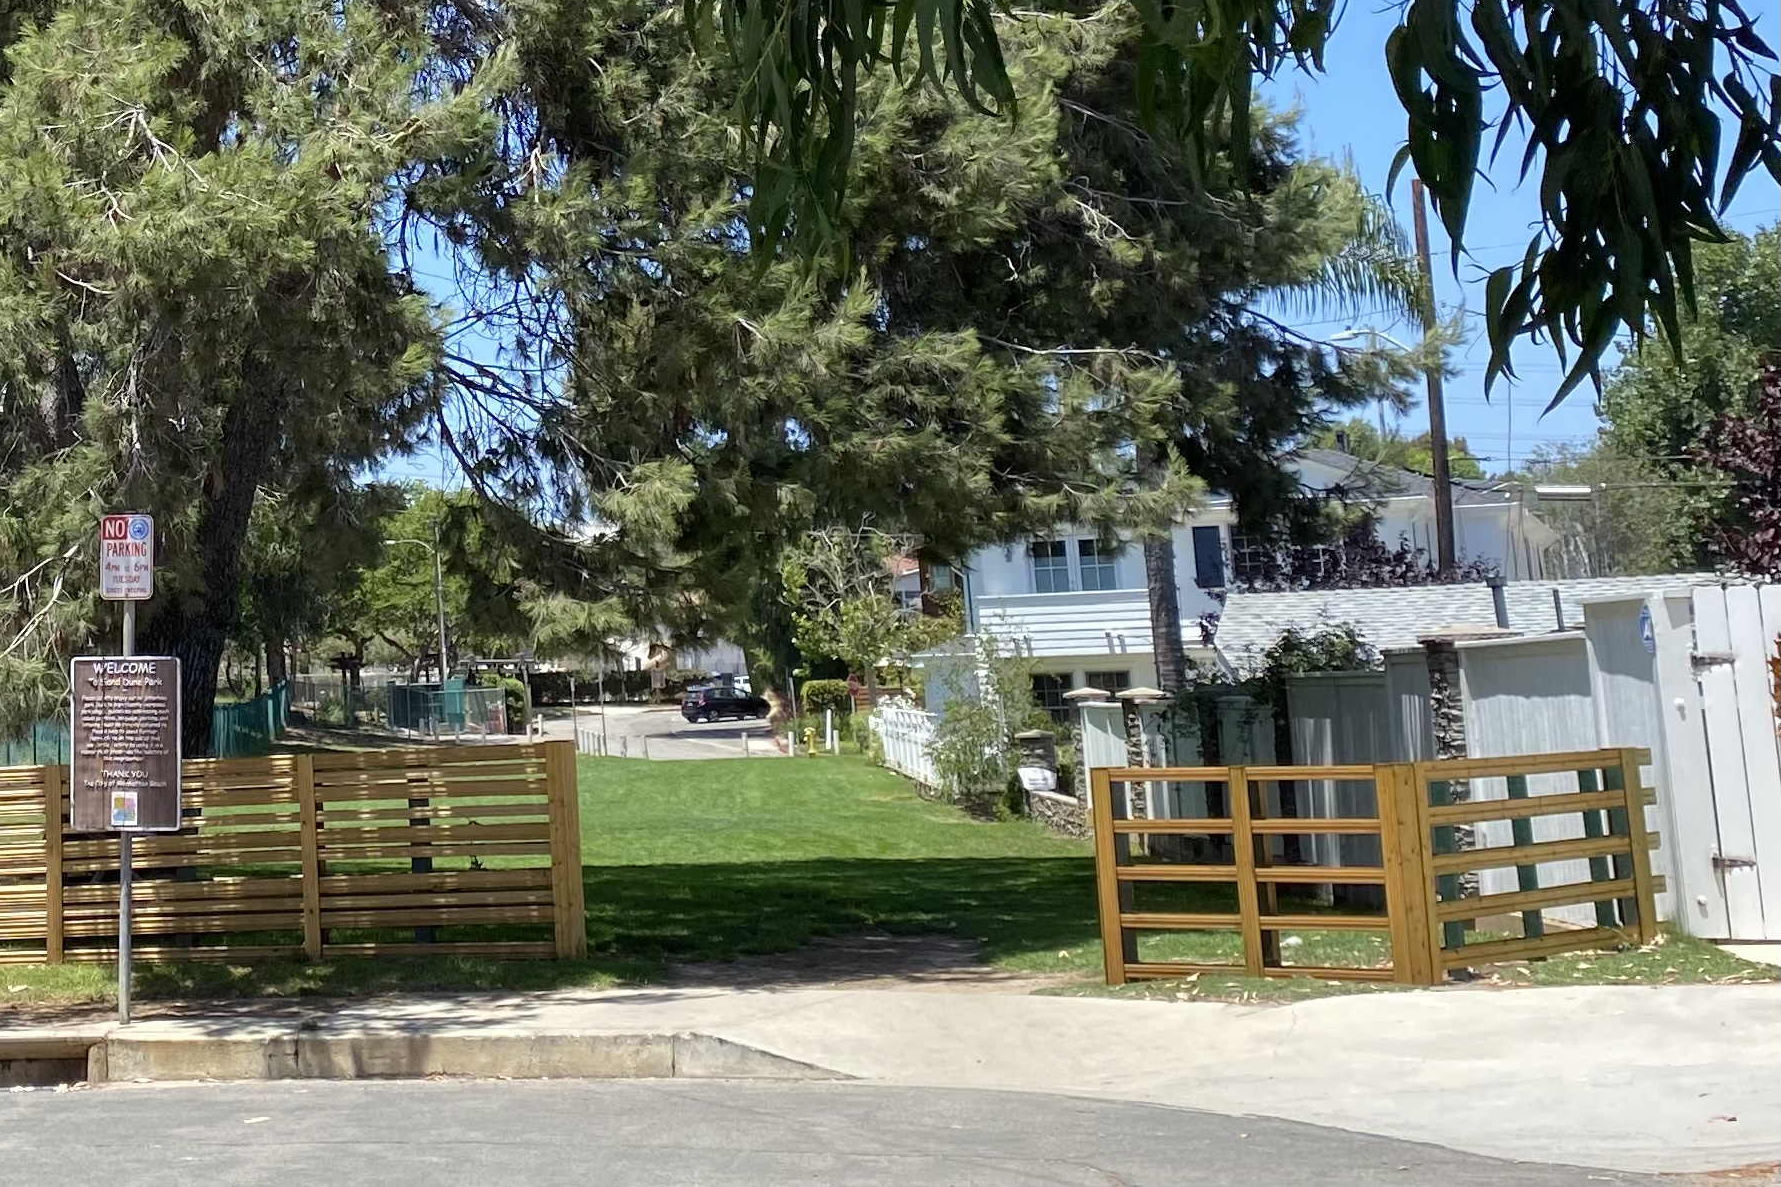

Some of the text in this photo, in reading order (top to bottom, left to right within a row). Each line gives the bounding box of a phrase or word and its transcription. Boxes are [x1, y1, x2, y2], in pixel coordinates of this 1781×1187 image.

[105, 519, 124, 538] NO
[106, 542, 147, 558] PARKING
[113, 575, 141, 584] TUESDAY
[93, 662, 157, 674] WELCOME
[88, 677, 98, 686] To
[122, 677, 142, 686] Dune
[144, 677, 163, 686] Park
[101, 770, 149, 778] THANK YOU
